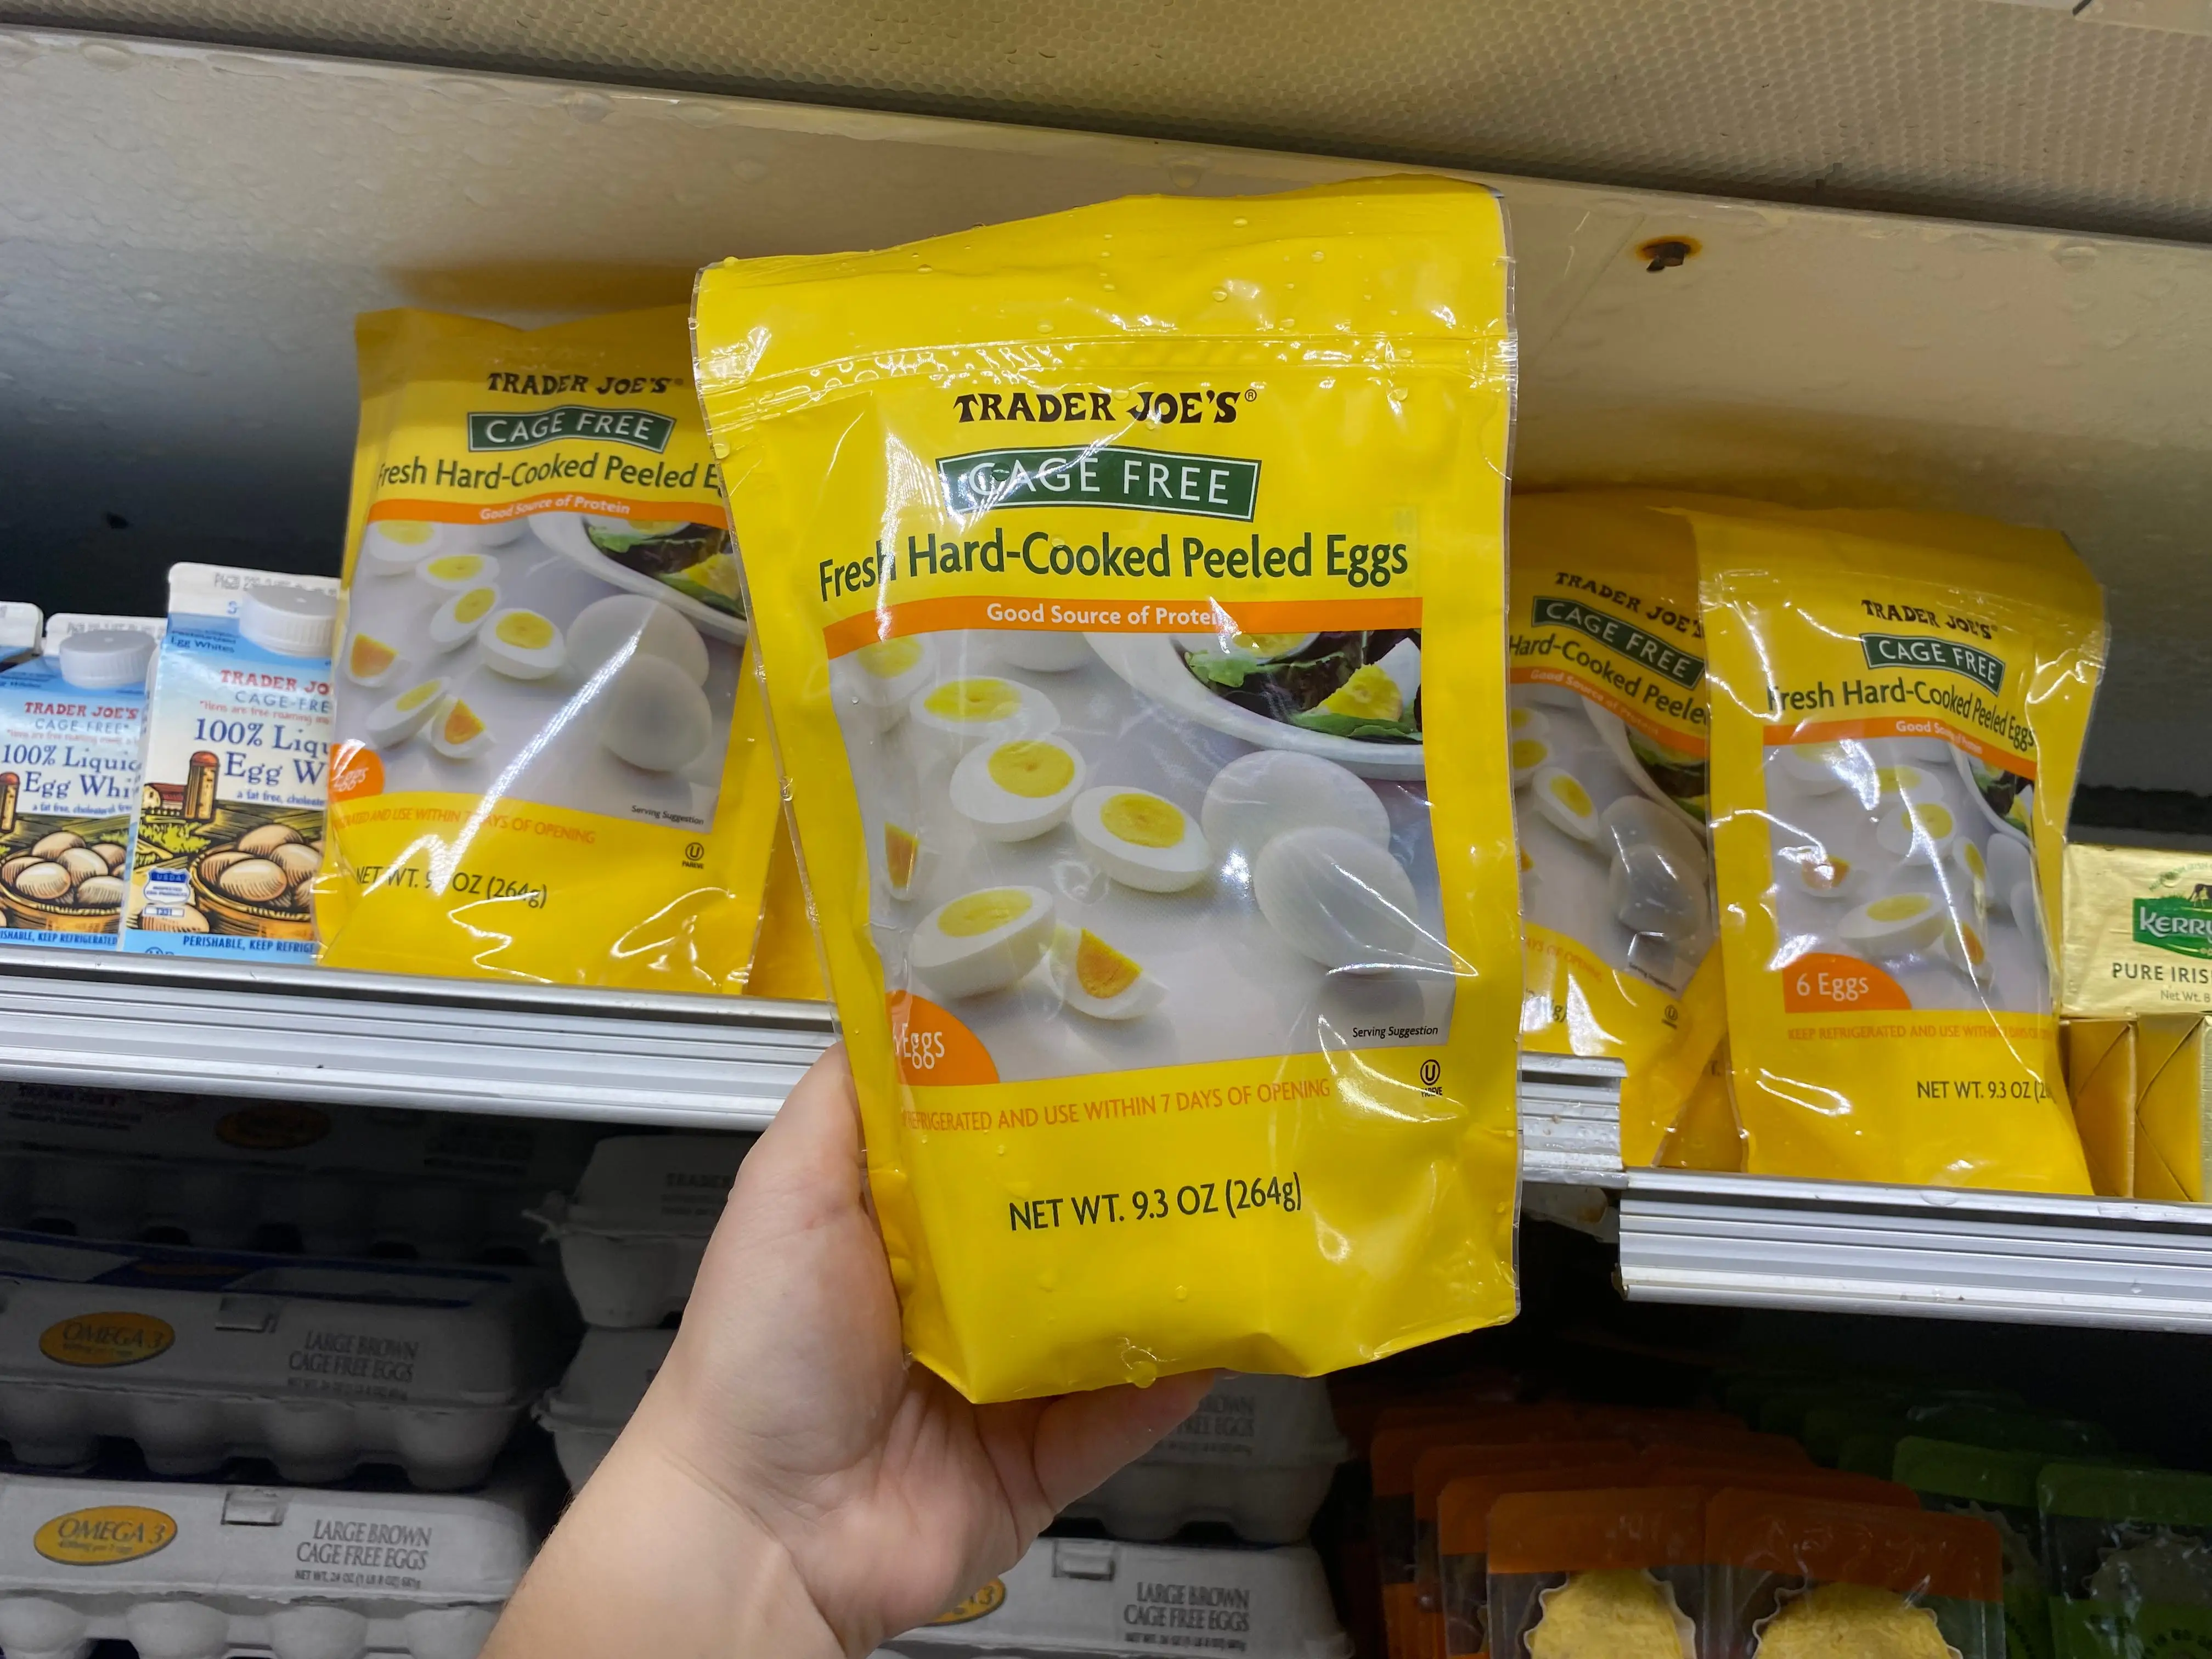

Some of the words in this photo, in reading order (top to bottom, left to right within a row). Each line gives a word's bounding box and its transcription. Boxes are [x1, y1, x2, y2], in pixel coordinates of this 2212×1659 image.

[488, 373, 589, 394] TRADER
[953, 392, 1116, 422] TRADER
[487, 412, 565, 443] CAGE
[576, 413, 654, 440] FREE
[436, 453, 599, 489] Hard-Cooked
[604, 455, 698, 488] Peeled
[969, 458, 1100, 495] CAGE
[1124, 460, 1229, 504] FREE
[479, 505, 513, 520] Good
[515, 498, 552, 514] Source
[555, 495, 573, 507] of
[574, 496, 630, 514] Protein
[820, 540, 897, 601] Fresh
[908, 528, 1170, 577] Hard-Cooked
[1183, 532, 1312, 578] Peeled
[1327, 534, 1408, 588] Eggs
[1555, 572, 1641, 612] TRADER
[988, 603, 1044, 623] Good
[1052, 605, 1120, 625] Source
[1127, 606, 1150, 625] of
[1156, 606, 1219, 625] Protei
[1861, 600, 1940, 628] TRADER
[1547, 603, 1618, 643] CAGE
[1626, 633, 1691, 678] FREE
[1878, 640, 1946, 663] CAGE
[1952, 647, 1996, 683] FREE
[221, 669, 297, 691] TRADER
[1510, 634, 1641, 698] Hard-Cooked
[1643, 684, 1706, 725] Peele
[25, 702, 87, 717] TRADER
[92, 706, 139, 720] JOE'S
[1767, 681, 1834, 710] Fresh
[1842, 676, 1973, 719] Hard-Cooked
[1972, 697, 2008, 736] Peeled
[2008, 716, 2036, 752] Eggs
[195, 718, 263, 747] 100%
[1895, 720, 1931, 732] Good
[1, 744, 57, 766] 100%
[224, 751, 283, 786] Egg
[24, 771, 71, 799] Egg
[80, 774, 137, 797] Whi
[118, 803, 132, 811] fre
[631, 805, 661, 819] Serving
[662, 811, 704, 825] Suggestion
[415, 808, 461, 822] WITHIN
[483, 812, 509, 829] AYS
[512, 817, 532, 832] OF
[534, 822, 596, 844] OPENING
[357, 866, 383, 884] NET
[452, 872, 483, 894] OZ
[487, 876, 548, 909] (264g)
[38, 933, 58, 942] KEEP
[60, 933, 118, 945] REFRIGERATED
[183, 935, 245, 951] PERISHABLE,
[249, 939, 273, 951] KEEP
[2112, 962, 2164, 981] PURE
[2171, 967, 2212, 984] IRIS
[1796, 973, 1810, 996] 6
[1818, 973, 1869, 1002] Eggs
[2160, 990, 2181, 1001] Net
[902, 1023, 945, 1069] Eggs
[1353, 1027, 1386, 1039] Serving
[1389, 1026, 1438, 1038] Suggestion
[1787, 1028, 1816, 1040] KEEP
[1819, 1025, 1906, 1039] REFRIGERATED
[1910, 1025, 1936, 1038] AND
[1939, 1025, 1960, 1037] USE
[1917, 1081, 1949, 1098] NET
[1954, 1081, 1984, 1098] WT.
[1988, 1081, 2007, 1098] 9.3
[2011, 1081, 2031, 1098] OZ
[907, 1111, 992, 1131] REFRIGERATED
[998, 1107, 1039, 1129] AND
[1044, 1103, 1079, 1125] USE
[1084, 1096, 1156, 1120] WITHIN
[1160, 1093, 1170, 1113] 7
[1176, 1088, 1223, 1111] DAYS
[1227, 1085, 1252, 1105] OF
[1257, 1079, 1330, 1103] OPENING
[1009, 1198, 1064, 1231] NET
[1071, 1193, 1125, 1225] WT.
[1132, 1189, 1169, 1220] 9.3
[1177, 1183, 1218, 1215] OZ
[1225, 1172, 1302, 1218] (264g)
[63, 1322, 145, 1347] OMEGA
[148, 1330, 165, 1348] 3
[58, 1517, 145, 1543] OMEGA
[148, 1523, 167, 1545] 3
[313, 1519, 367, 1543] LARGE
[366, 1523, 432, 1547] BROWN
[296, 1542, 342, 1565] CAGE
[343, 1545, 382, 1567] FREE
[383, 1548, 428, 1570] EGGS
[1136, 1582, 1186, 1604] LARGE
[1124, 1604, 1167, 1626] CAGE
[1207, 1610, 1250, 1632] EGGS
